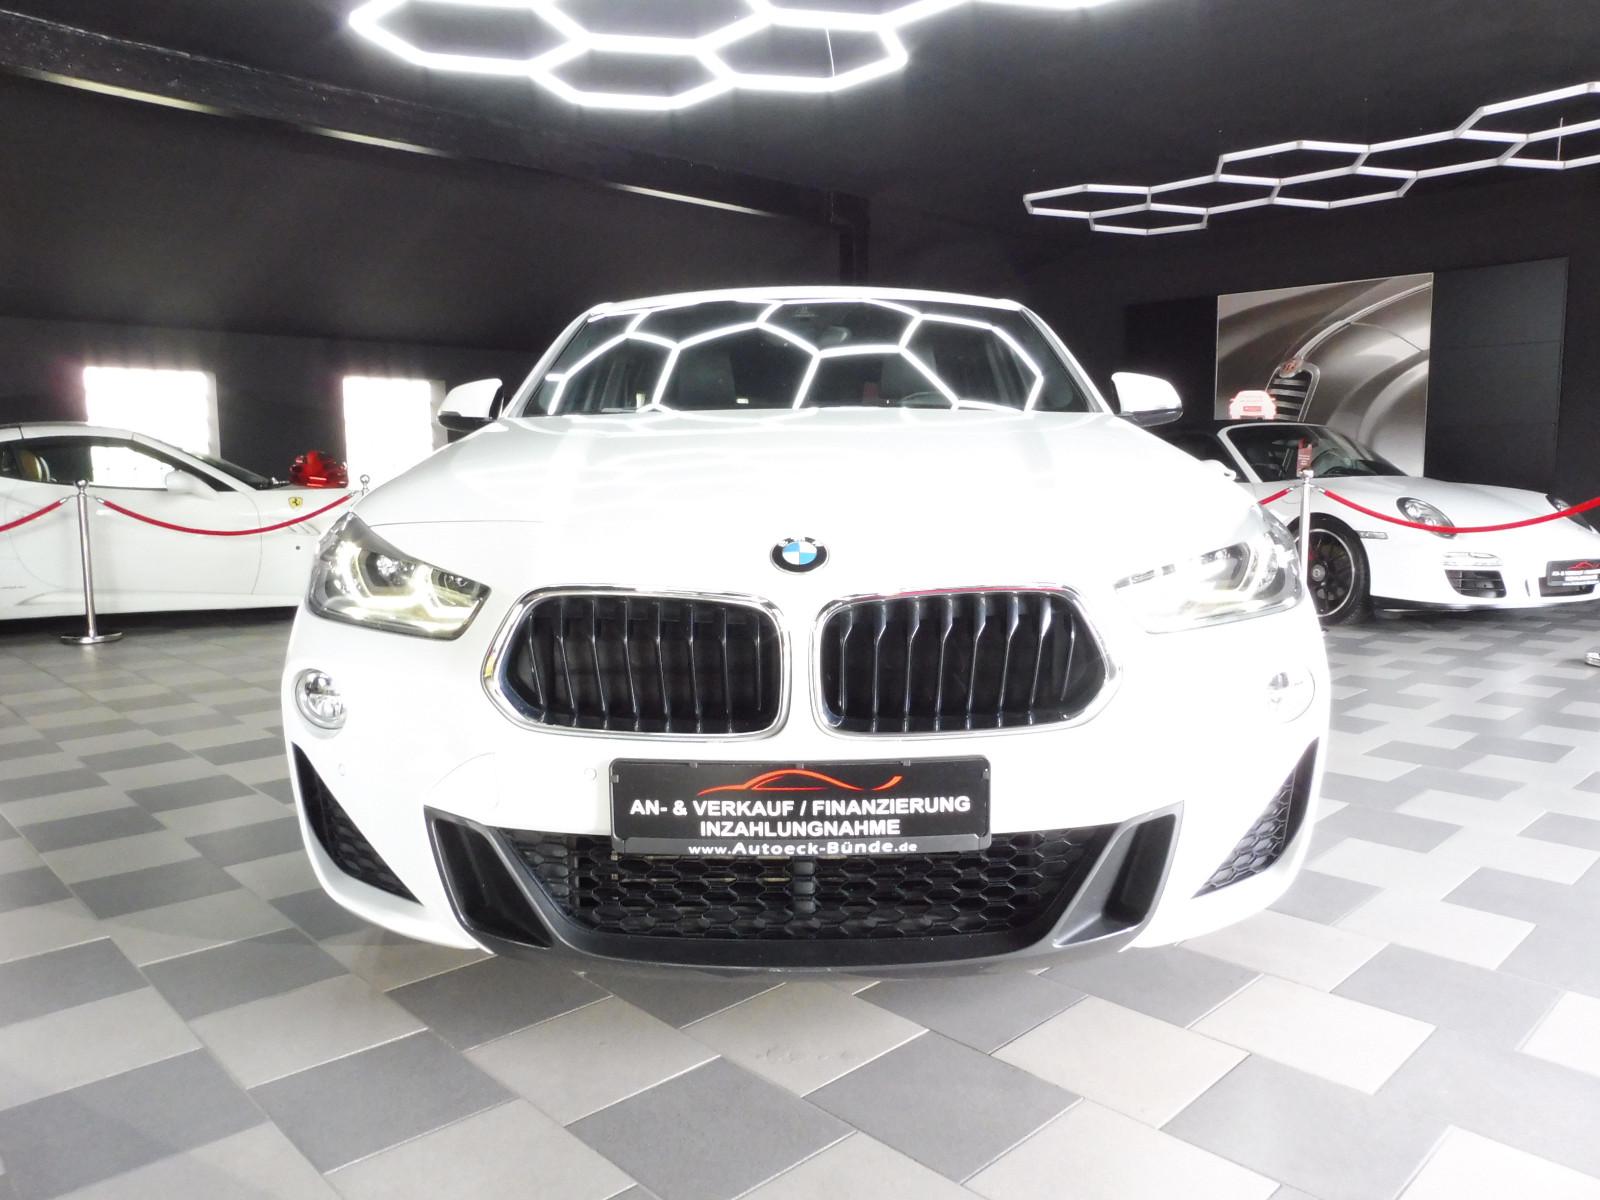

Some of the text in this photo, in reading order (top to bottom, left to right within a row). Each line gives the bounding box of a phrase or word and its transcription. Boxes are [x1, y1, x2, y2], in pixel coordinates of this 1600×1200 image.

[630, 800, 668, 815] AN-
[672, 800, 687, 816] &
[693, 799, 794, 816] VERKAUF
[813, 796, 971, 815] FINANZIERUNG
[700, 819, 900, 837] INZAHLUNGNAHME
[688, 840, 918, 855] www.Autoeck-Bünde.de
